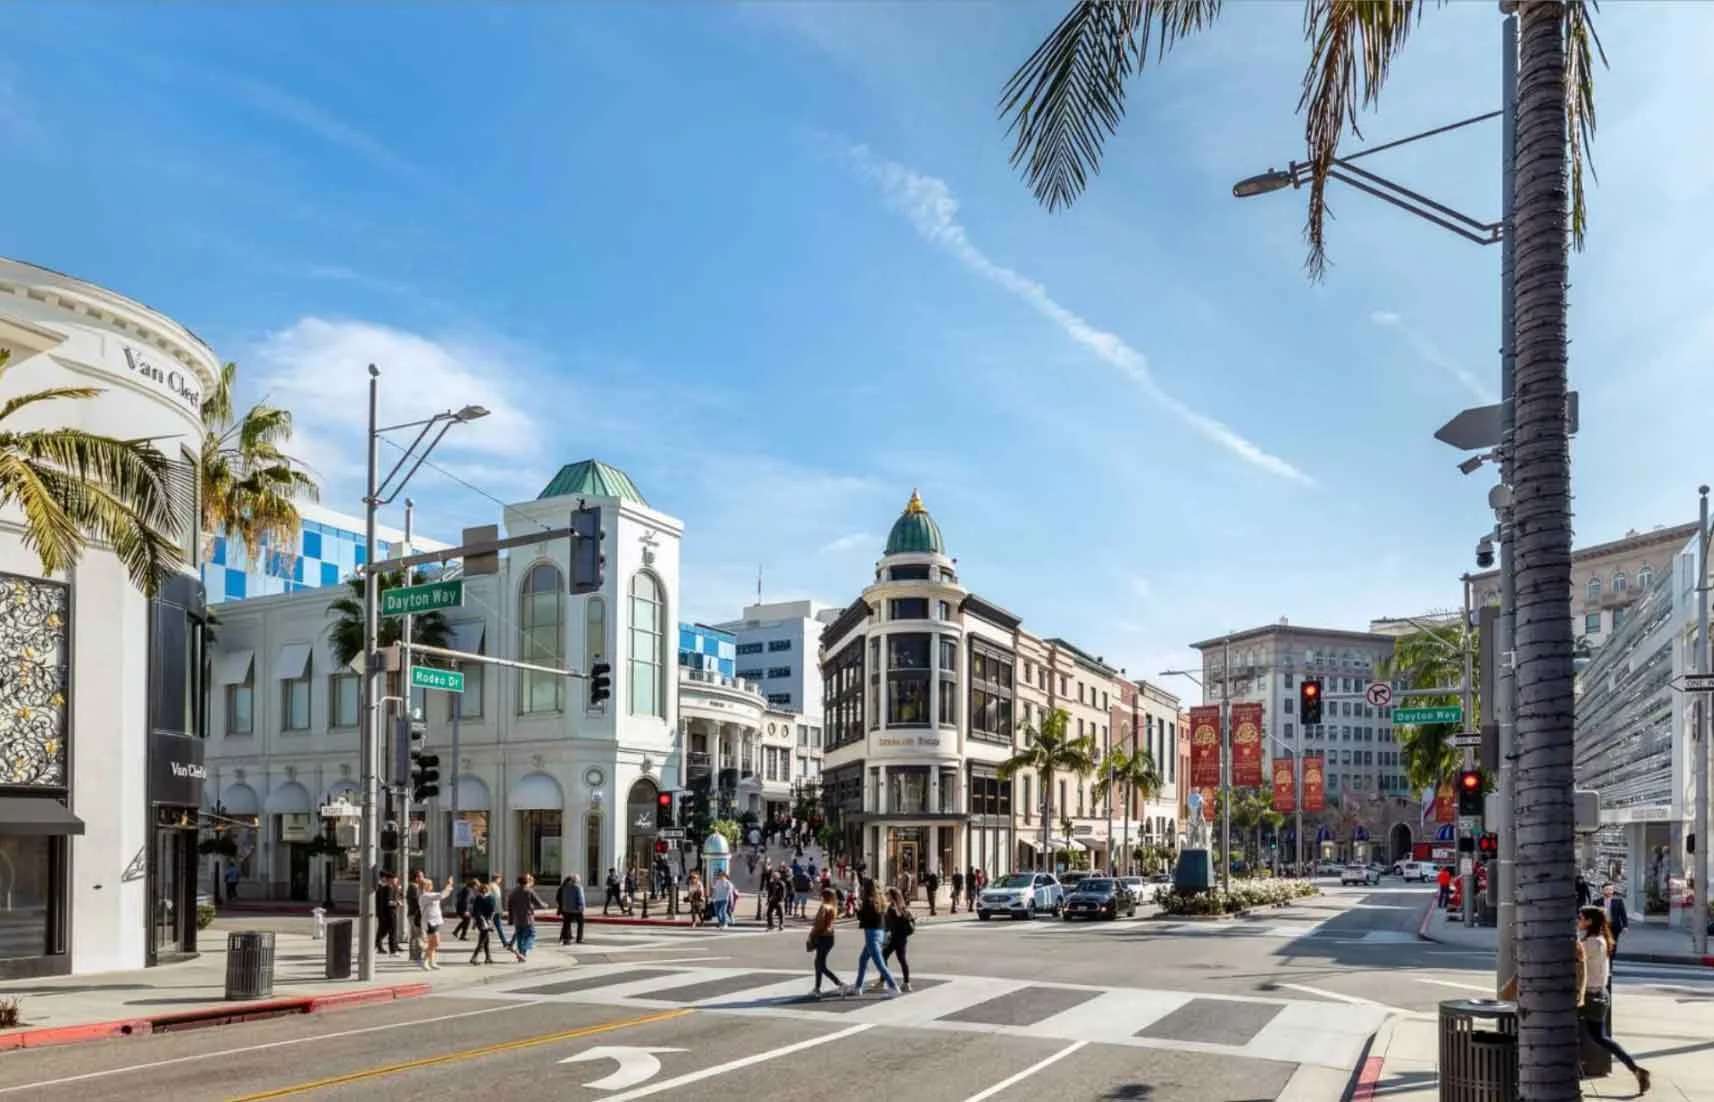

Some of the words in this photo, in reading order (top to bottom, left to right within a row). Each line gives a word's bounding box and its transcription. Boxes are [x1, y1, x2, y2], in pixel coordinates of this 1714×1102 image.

[123, 346, 164, 384] Van
[387, 593, 430, 610] Dayton
[432, 589, 456, 604] Way
[416, 672, 445, 685] Rodeo
[448, 677, 458, 687] Dr
[1397, 711, 1432, 722] Dayton
[1436, 711, 1456, 720] Way
[170, 761, 188, 777] Van
